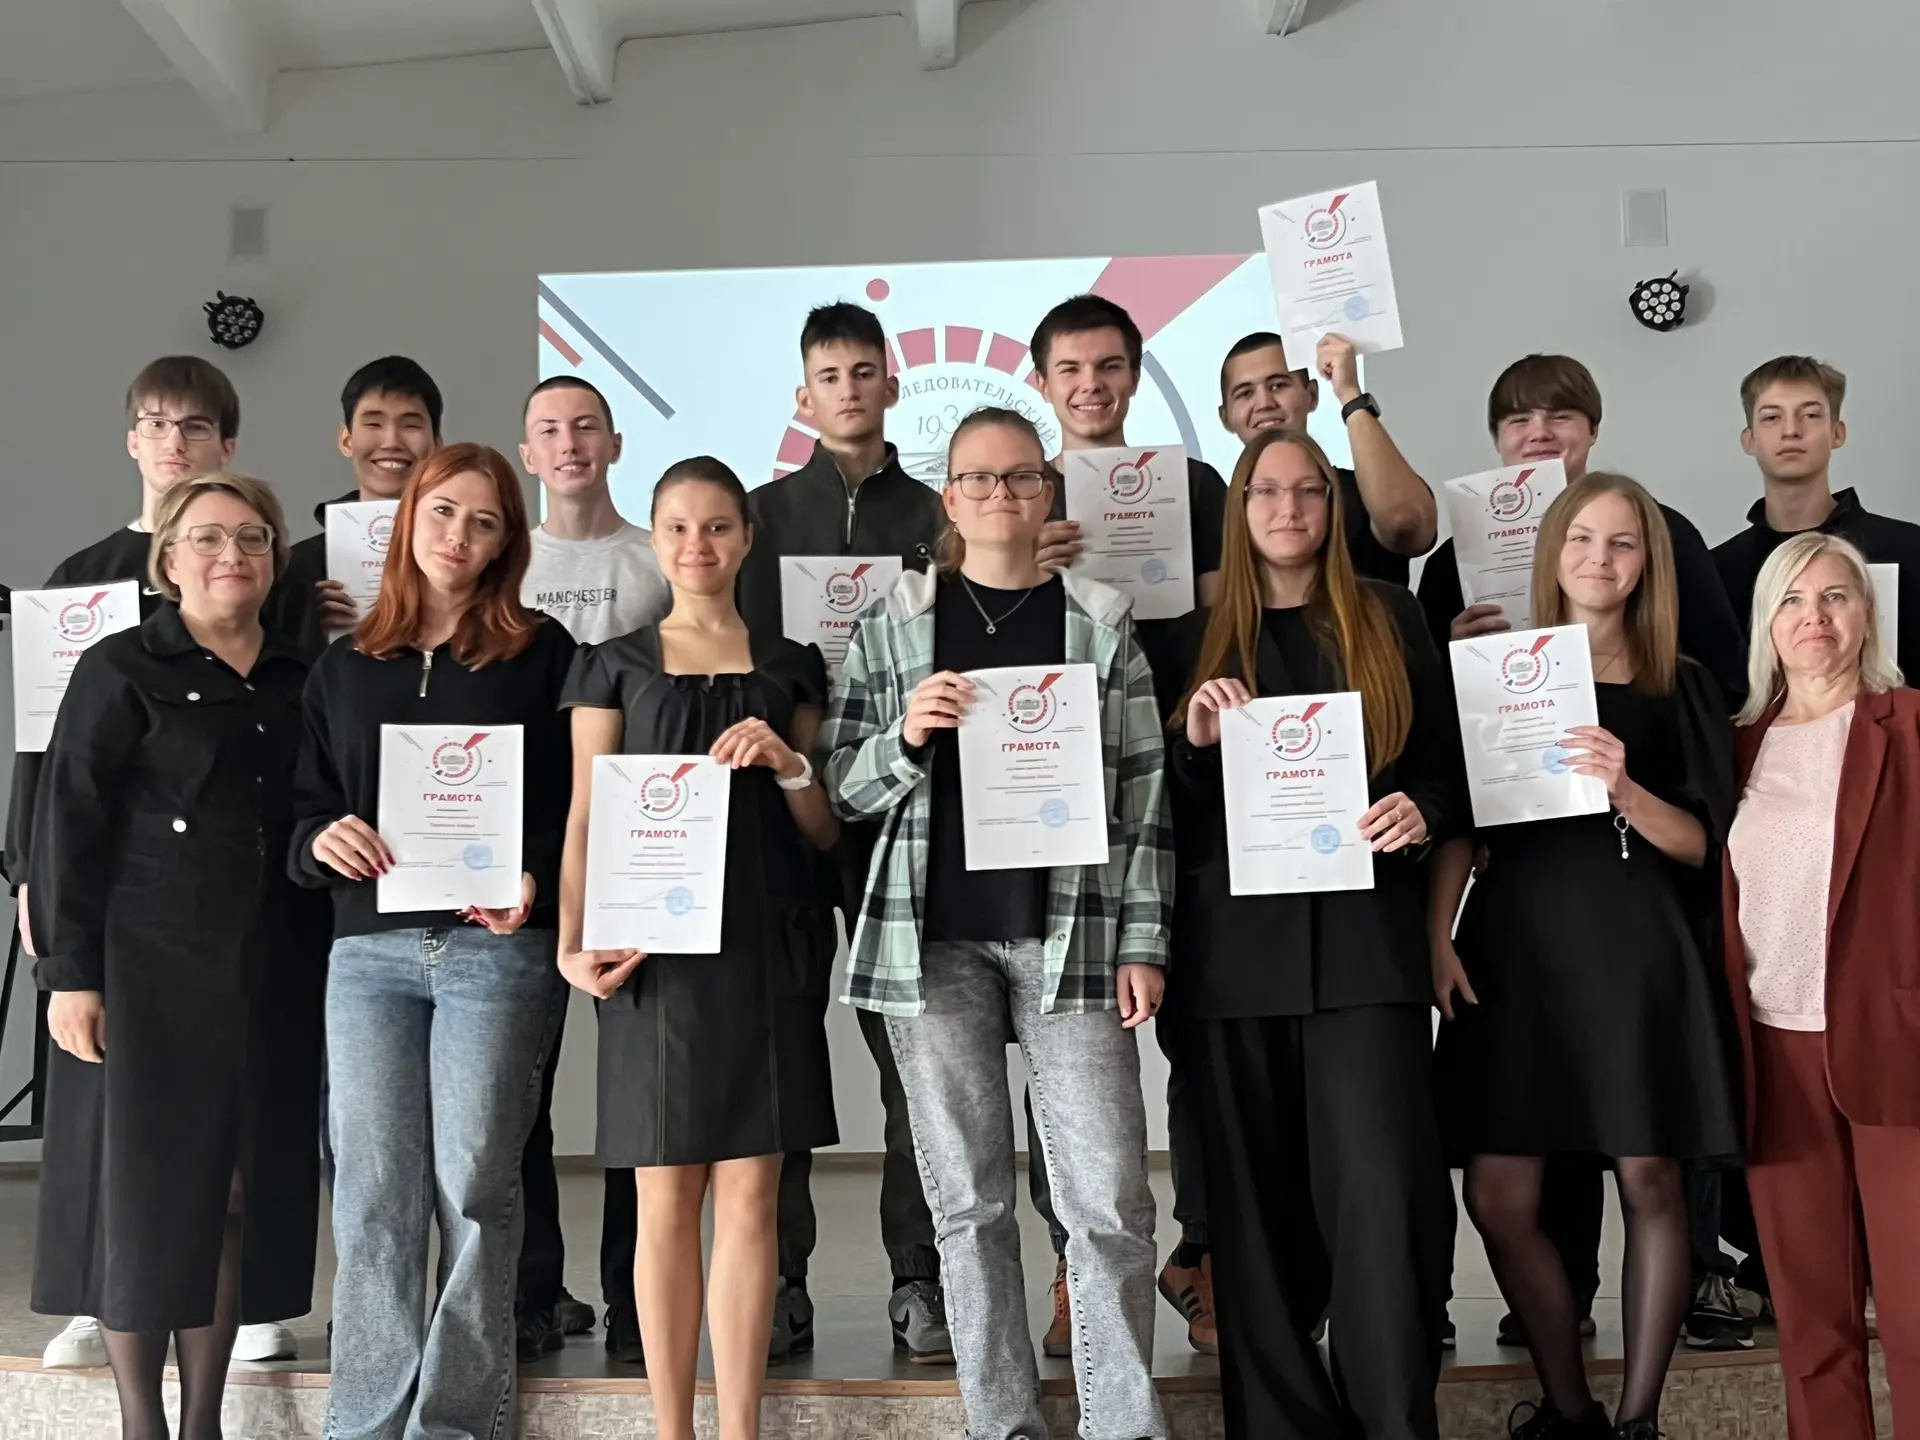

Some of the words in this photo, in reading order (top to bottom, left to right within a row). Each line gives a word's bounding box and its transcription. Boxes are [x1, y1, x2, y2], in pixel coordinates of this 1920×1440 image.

[1303, 252, 1353, 269] ГРАМОТА
[901, 377, 1057, 443] ЛЕДОВАТЕЛЬСКИЙ
[917, 404, 961, 444] 193
[1104, 511, 1155, 521] ГРАМОТА
[1488, 526, 1538, 540] ГРАМОТА
[536, 588, 617, 605] MANCHESTER
[1498, 699, 1555, 714] ГРАМОТА
[1001, 741, 1061, 752] ГРАМОТА
[1265, 768, 1325, 780] ГРАМОТА
[423, 793, 483, 802] ГРАМОТА
[630, 829, 687, 838] ГРАМОТА
